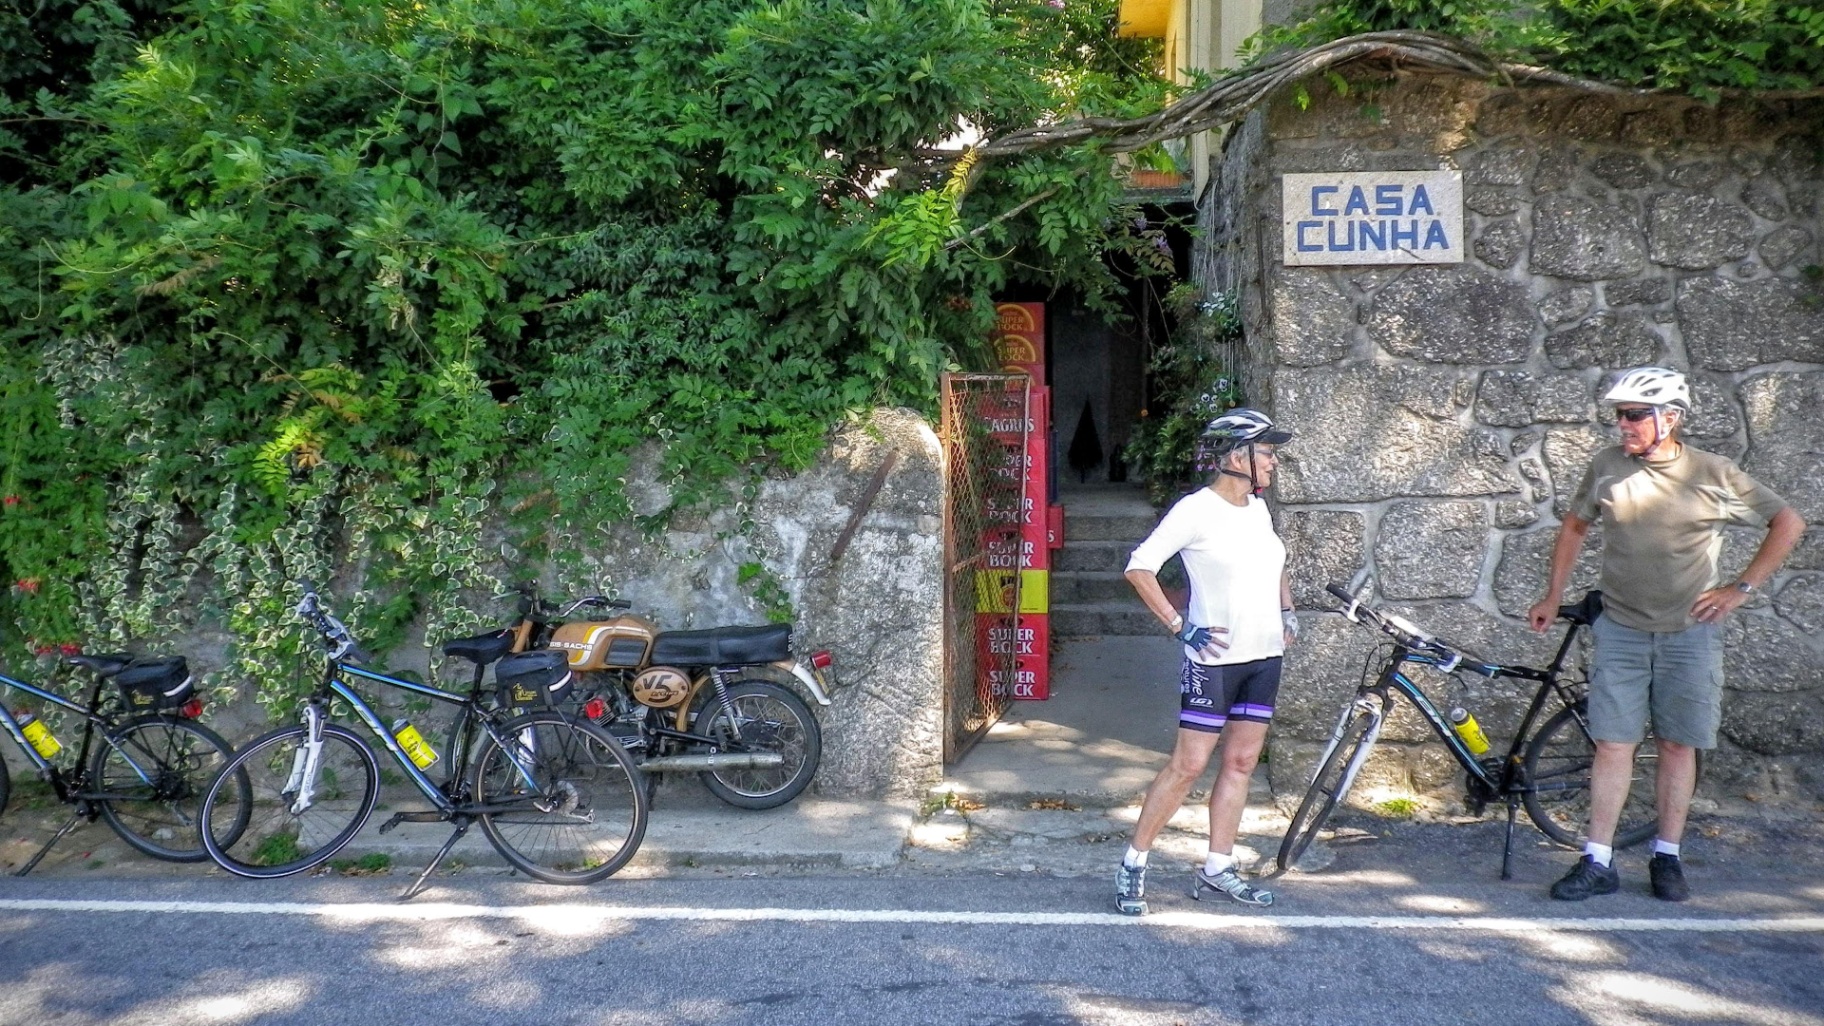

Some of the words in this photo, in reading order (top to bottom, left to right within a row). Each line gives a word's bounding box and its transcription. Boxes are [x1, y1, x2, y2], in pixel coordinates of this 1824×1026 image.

[1311, 183, 1434, 216] CASA
[1297, 219, 1450, 252] CUNHA
[984, 417, 1035, 432] AGRS
[643, 675, 673, 703] V5
